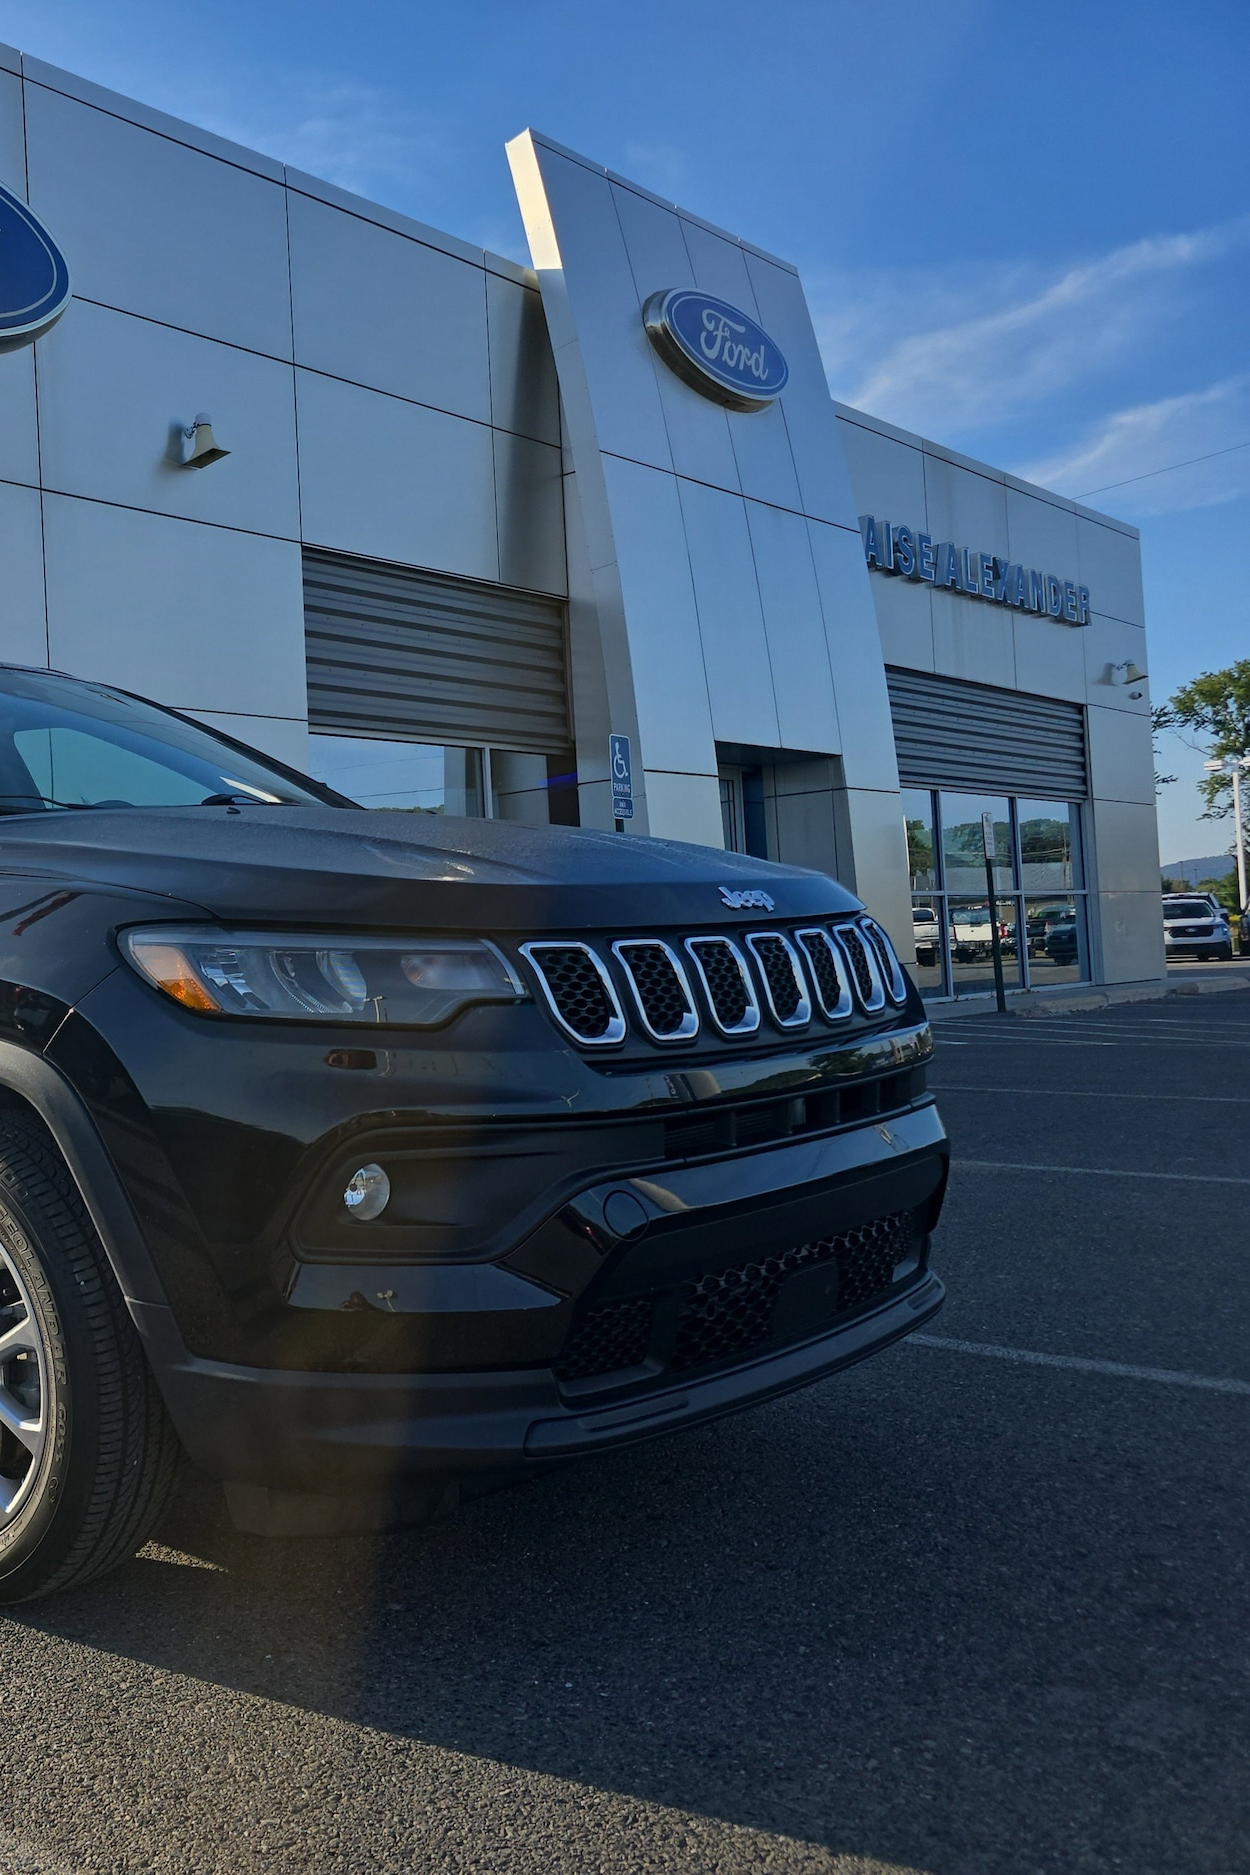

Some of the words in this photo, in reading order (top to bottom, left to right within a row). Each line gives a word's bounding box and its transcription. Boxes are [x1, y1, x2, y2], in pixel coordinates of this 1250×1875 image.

[699, 308, 770, 381] Ford
[935, 541, 1093, 626] ALEXANDER
[613, 782, 631, 793] PARKING
[717, 886, 775, 912] Jeep
